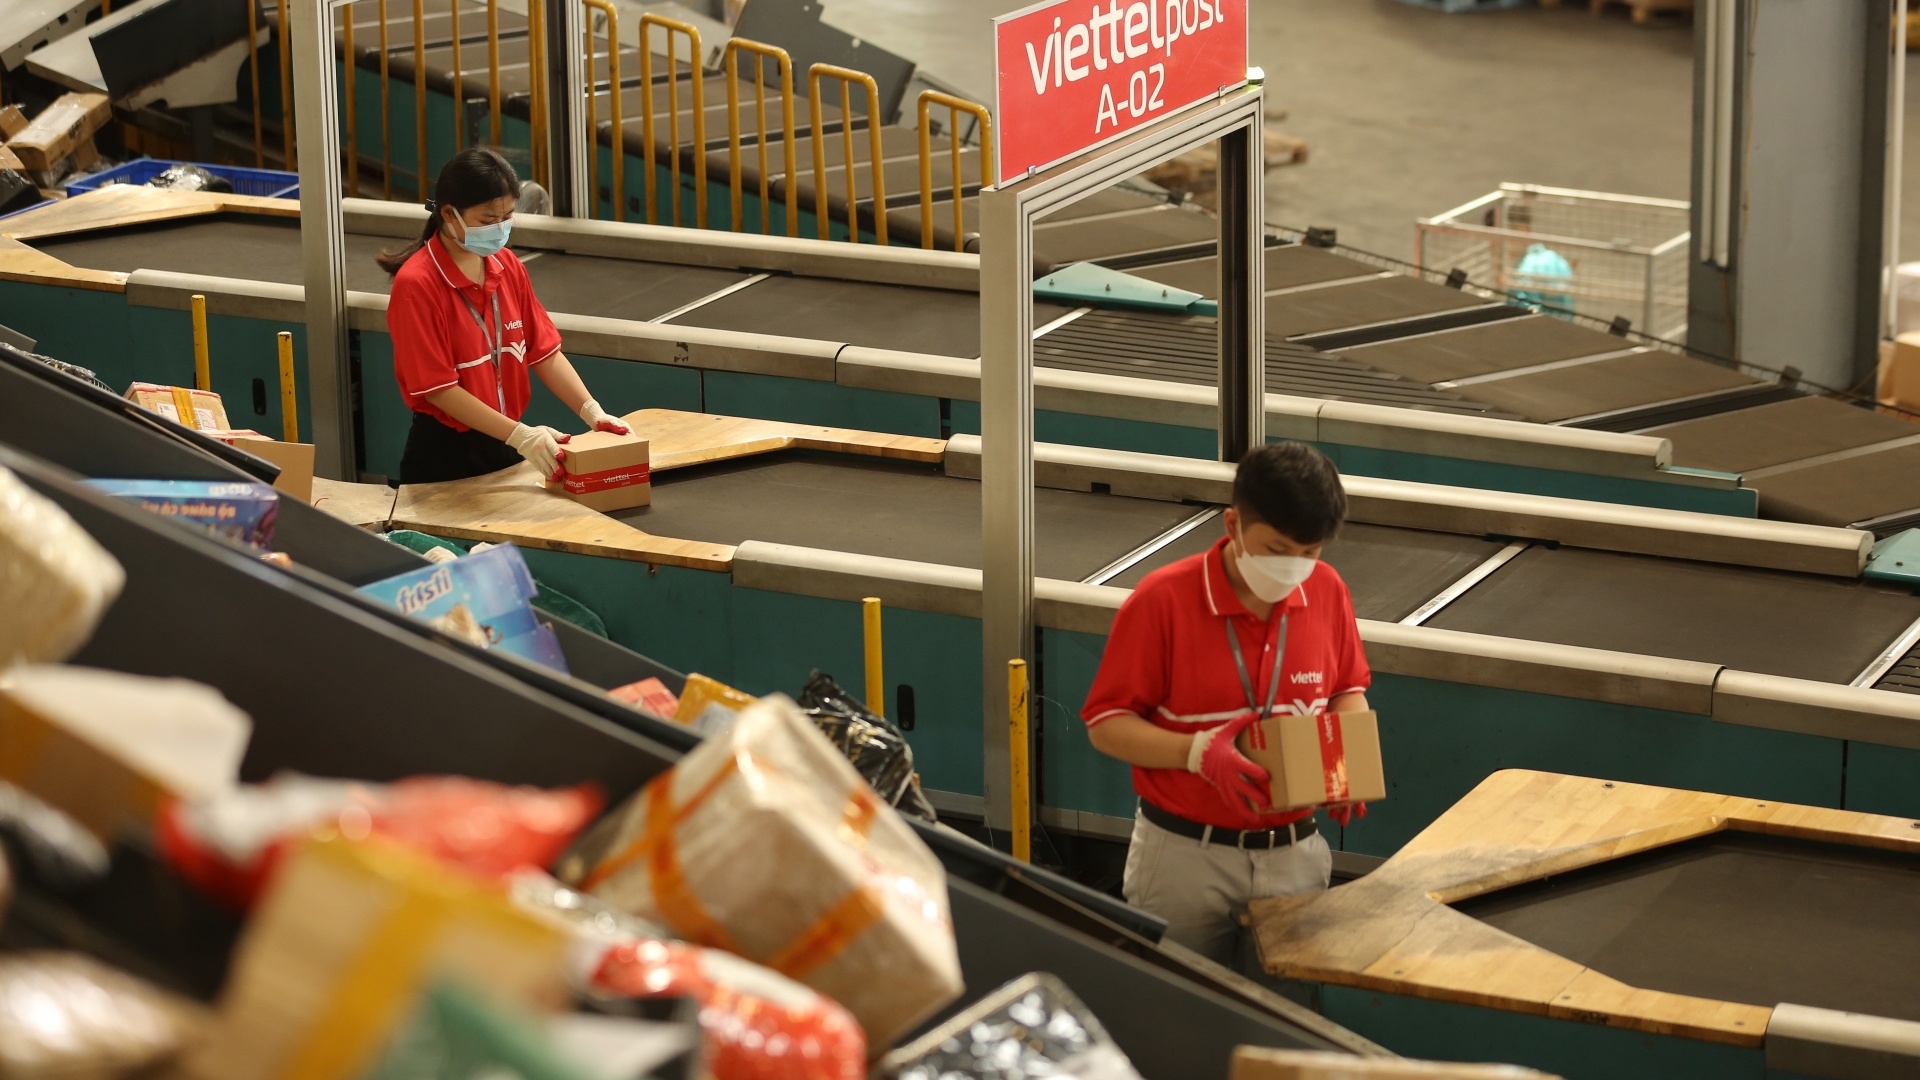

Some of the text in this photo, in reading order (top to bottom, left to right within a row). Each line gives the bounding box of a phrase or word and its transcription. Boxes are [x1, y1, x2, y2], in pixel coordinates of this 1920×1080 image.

[1094, 63, 1164, 134] A-02
[602, 473, 630, 484] viettel
[398, 568, 453, 614] fristi
[1290, 671, 1323, 684] viettel
